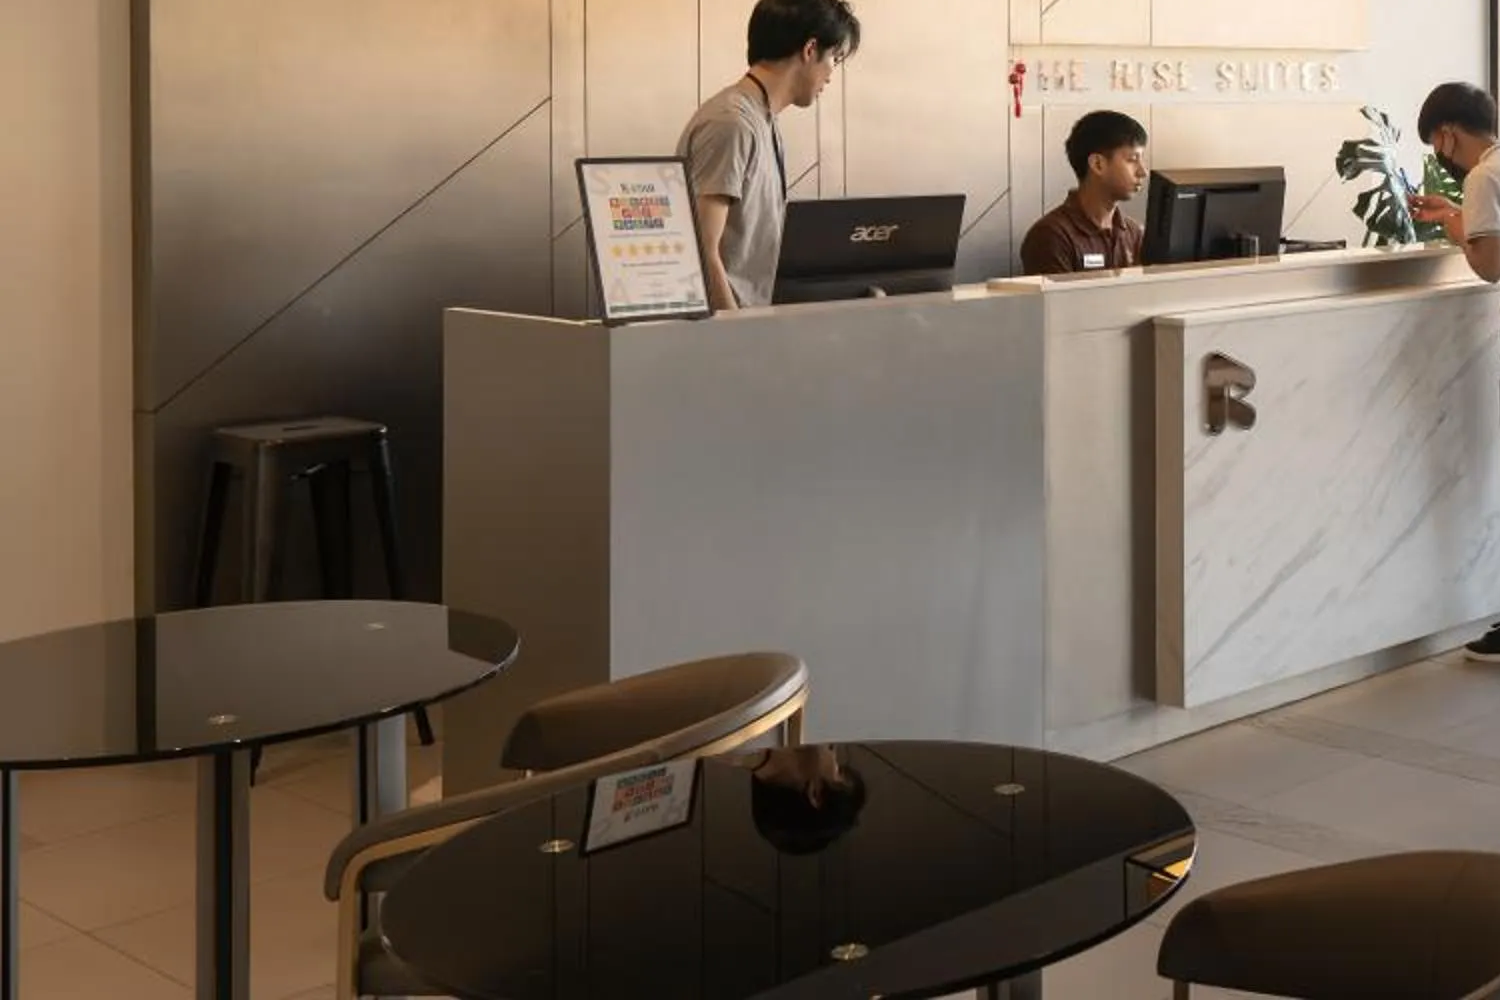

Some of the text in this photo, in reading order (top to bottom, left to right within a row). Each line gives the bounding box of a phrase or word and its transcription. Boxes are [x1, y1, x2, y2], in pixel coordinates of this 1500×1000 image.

[1008, 57, 1342, 94] HE RISE SUITES
[850, 224, 900, 241] acer
